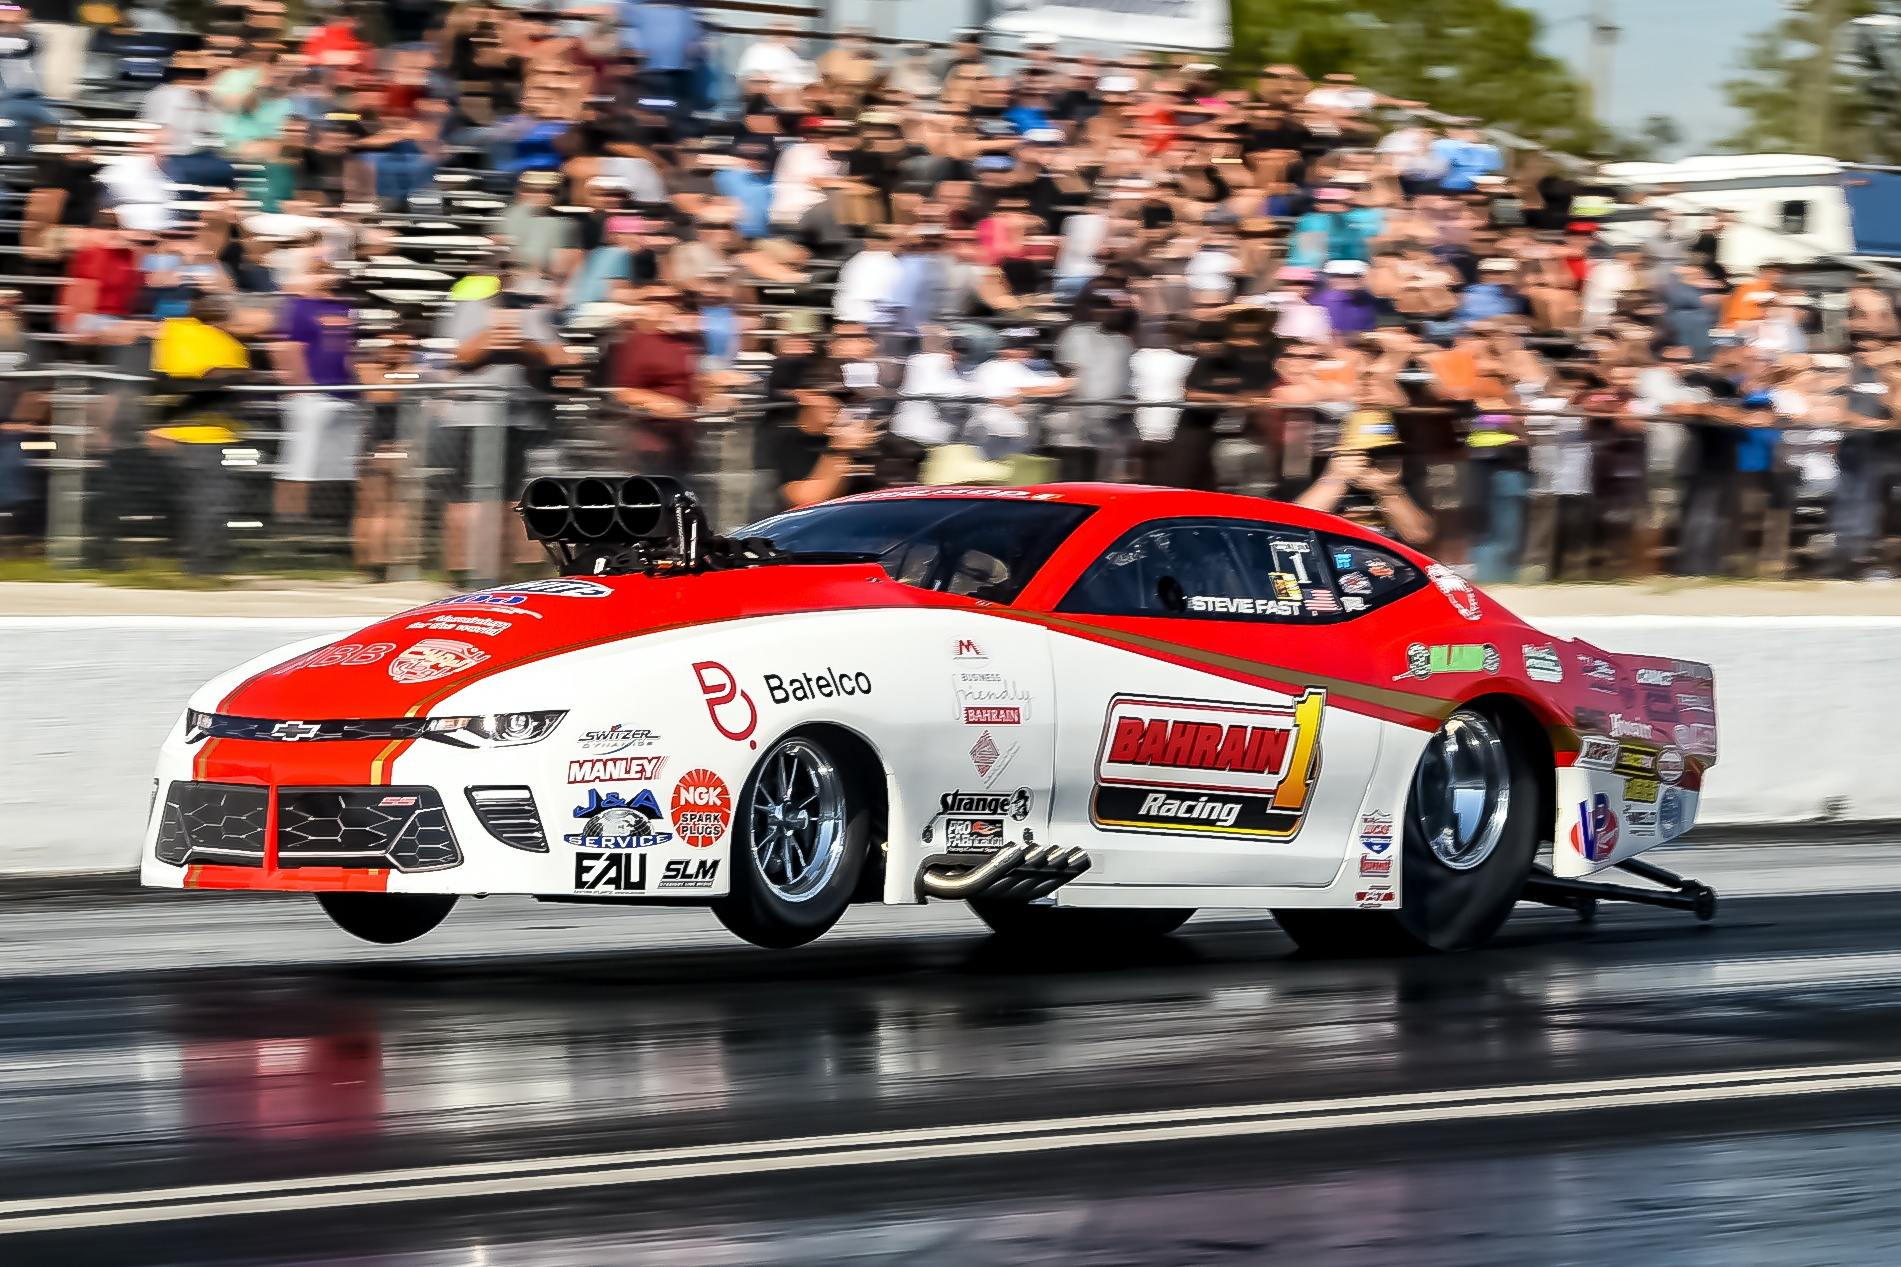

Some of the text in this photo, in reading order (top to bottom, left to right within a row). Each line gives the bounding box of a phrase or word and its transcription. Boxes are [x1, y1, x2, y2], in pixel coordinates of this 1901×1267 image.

[1189, 596, 1301, 615] STEVIE FAST
[763, 667, 872, 704] Batelco
[967, 709, 1019, 723] BAHRAIN
[578, 729, 661, 741] SWITZER
[1106, 716, 1292, 775] BAHRAIN
[1271, 690, 1323, 810] 1
[567, 756, 662, 784] MANLEY
[573, 789, 664, 819] J&A
[679, 787, 723, 806] NGK
[939, 788, 1011, 815] Strange
[681, 812, 720, 824] SPARK
[1138, 793, 1243, 826] Racing
[680, 824, 720, 836] PLUGS
[569, 834, 671, 849] SERVICE
[662, 859, 721, 880] SLM
